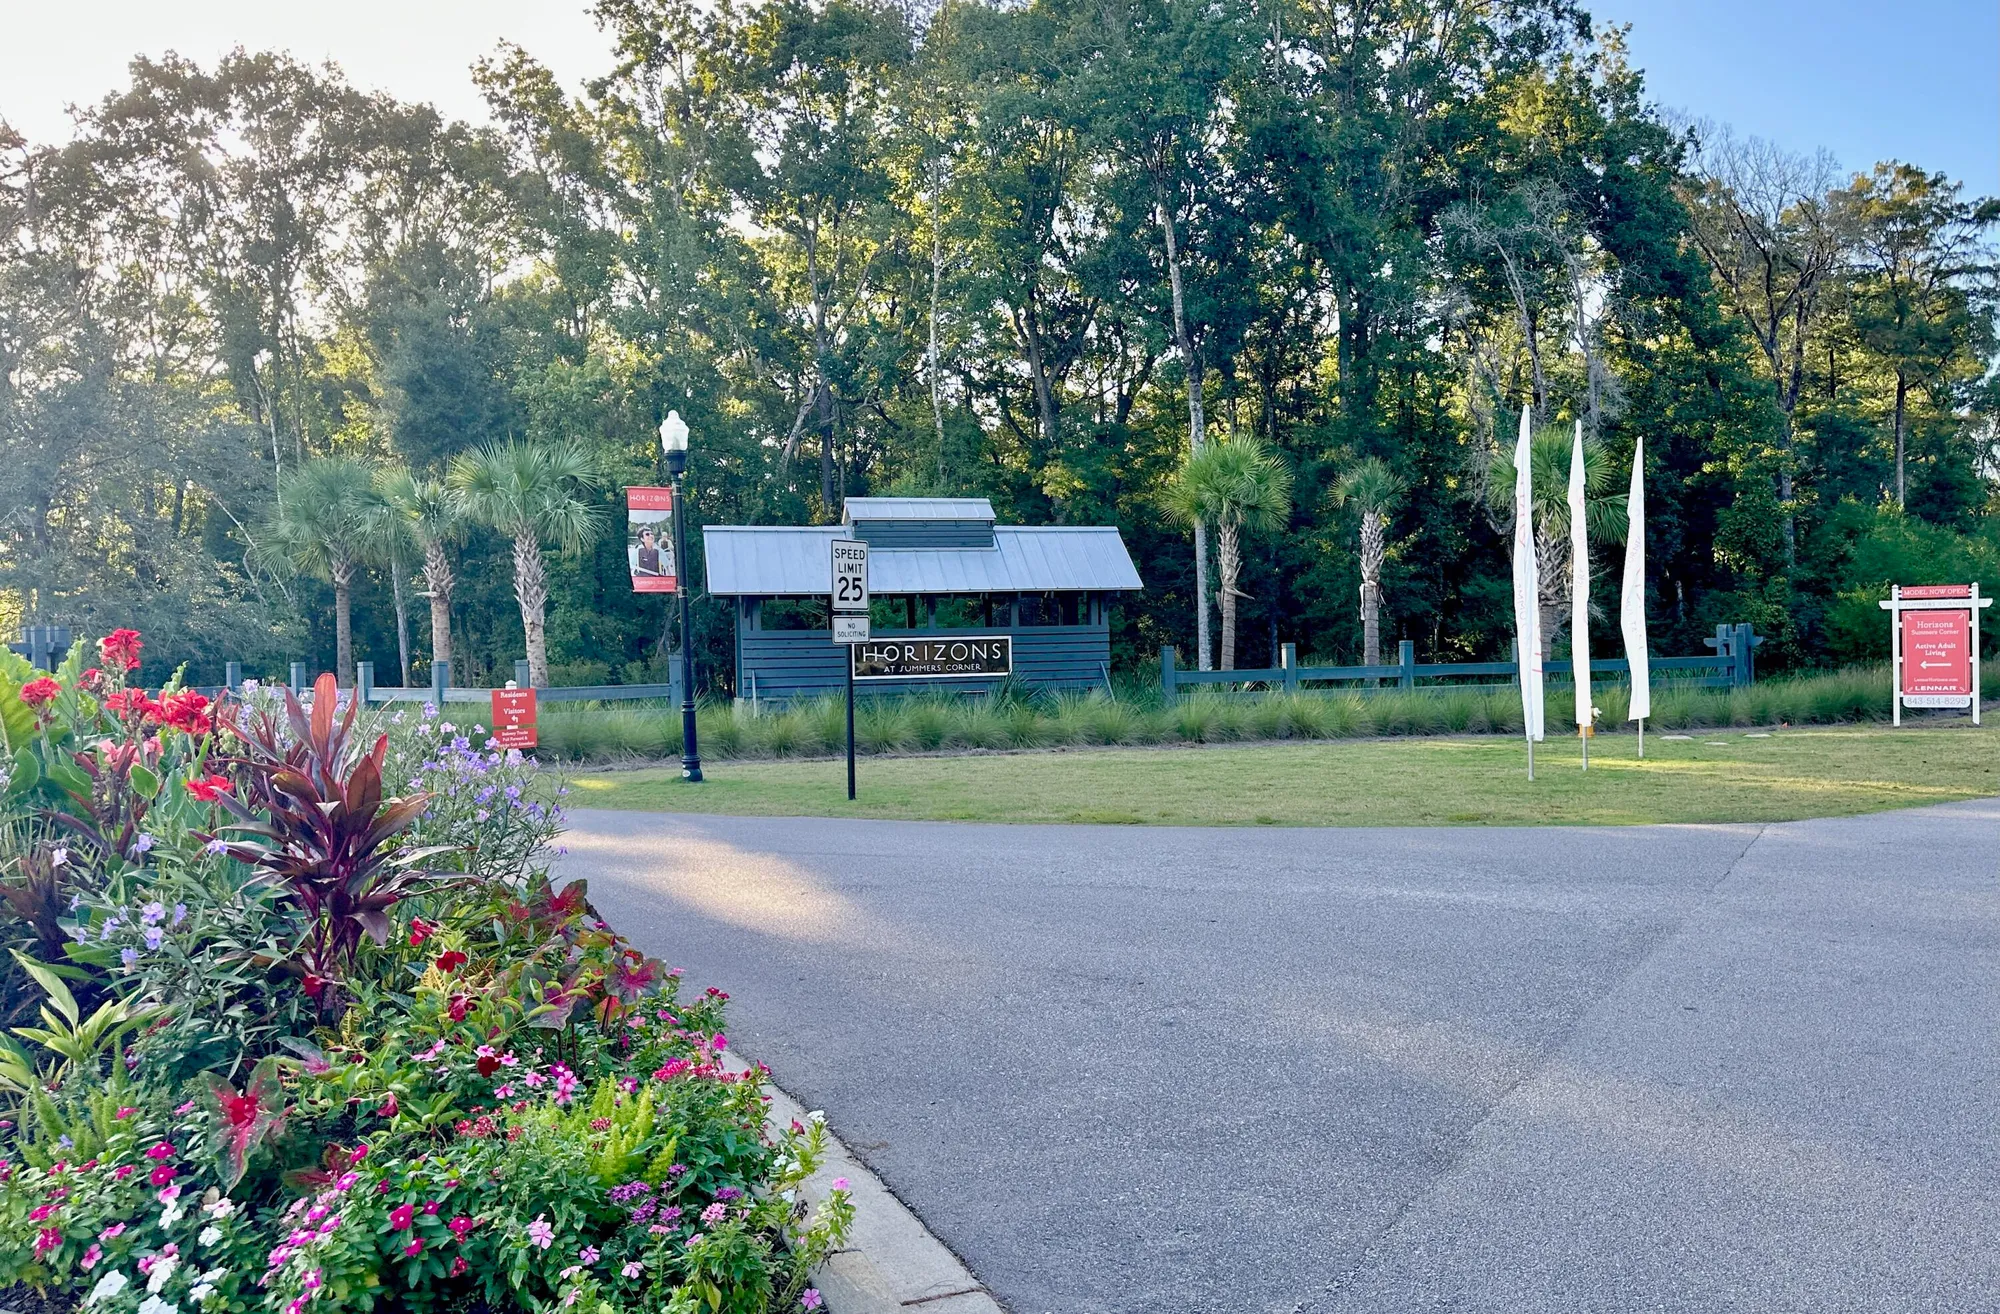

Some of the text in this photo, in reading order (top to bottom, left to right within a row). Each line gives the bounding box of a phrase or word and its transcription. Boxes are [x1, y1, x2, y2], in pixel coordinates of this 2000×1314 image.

[629, 494, 670, 502] HORIZONS
[834, 548, 865, 560] SPEED
[838, 563, 863, 574] LIMIT
[838, 576, 863, 602] 25
[1916, 621, 1953, 629] Horizons
[862, 643, 1002, 662] HORIZONS
[884, 663, 982, 673] AT SUMMERS CORNER
[1906, 696, 1967, 705] 843-514-8295
